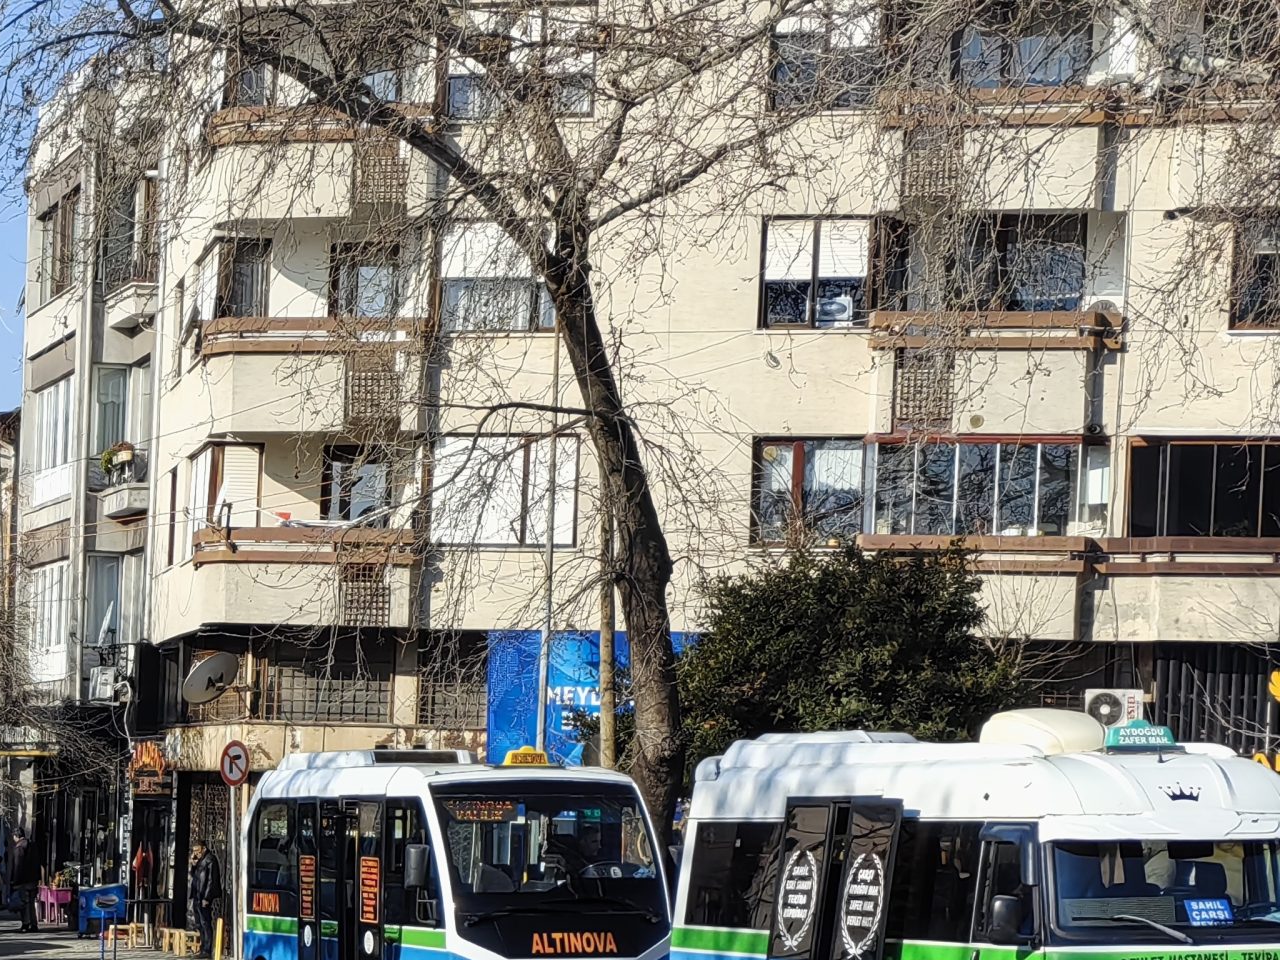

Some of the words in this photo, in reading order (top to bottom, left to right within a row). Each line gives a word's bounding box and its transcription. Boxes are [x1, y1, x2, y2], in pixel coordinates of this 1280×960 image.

[547, 686, 603, 705] MEYD
[1120, 726, 1164, 736] AYDOĞDU
[1118, 736, 1147, 744] ZAFER
[1190, 901, 1224, 909] SAHİL
[1192, 910, 1230, 920] ÇARŞI
[532, 932, 618, 954] ALTINOVA
